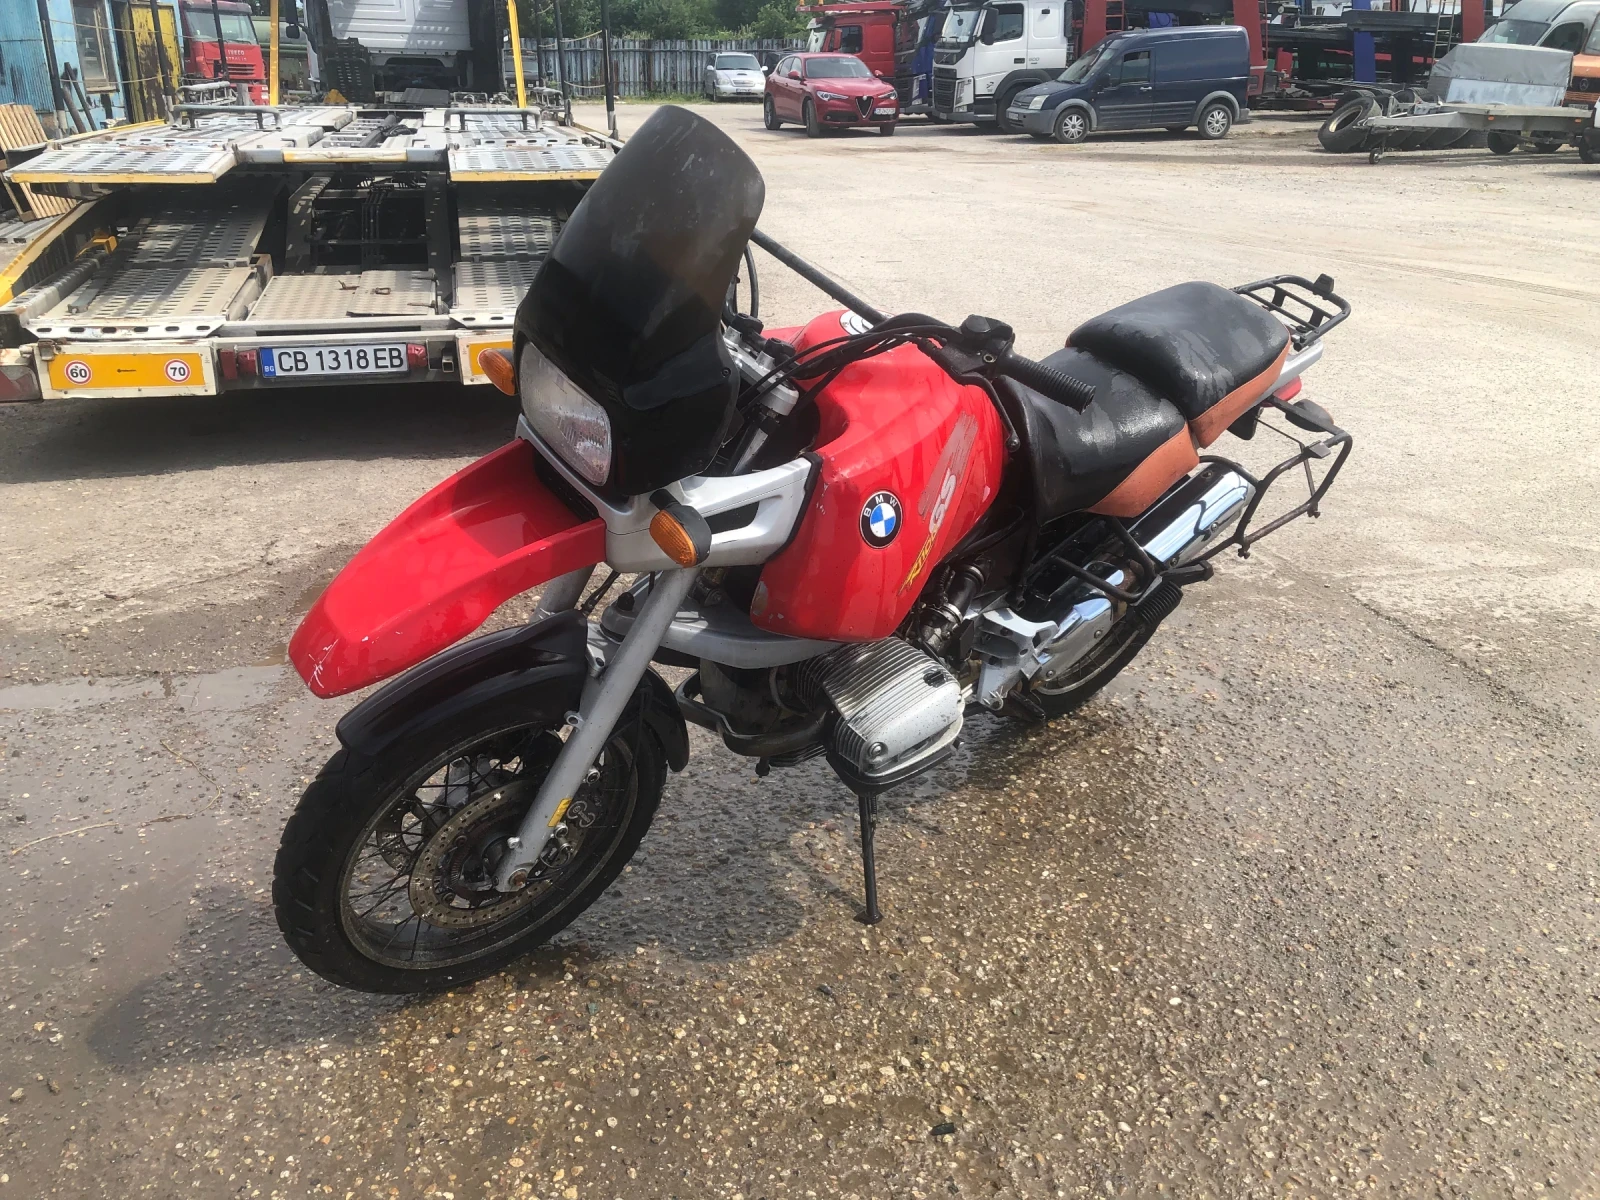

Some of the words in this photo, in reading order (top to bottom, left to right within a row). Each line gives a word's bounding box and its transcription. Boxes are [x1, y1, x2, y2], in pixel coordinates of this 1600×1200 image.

[277, 350, 309, 373] CB
[315, 348, 370, 372] 1318
[373, 346, 405, 369] EB
[69, 367, 88, 379] 60
[169, 366, 186, 377] 70
[264, 365, 275, 373] BG
[863, 493, 898, 518] BMW
